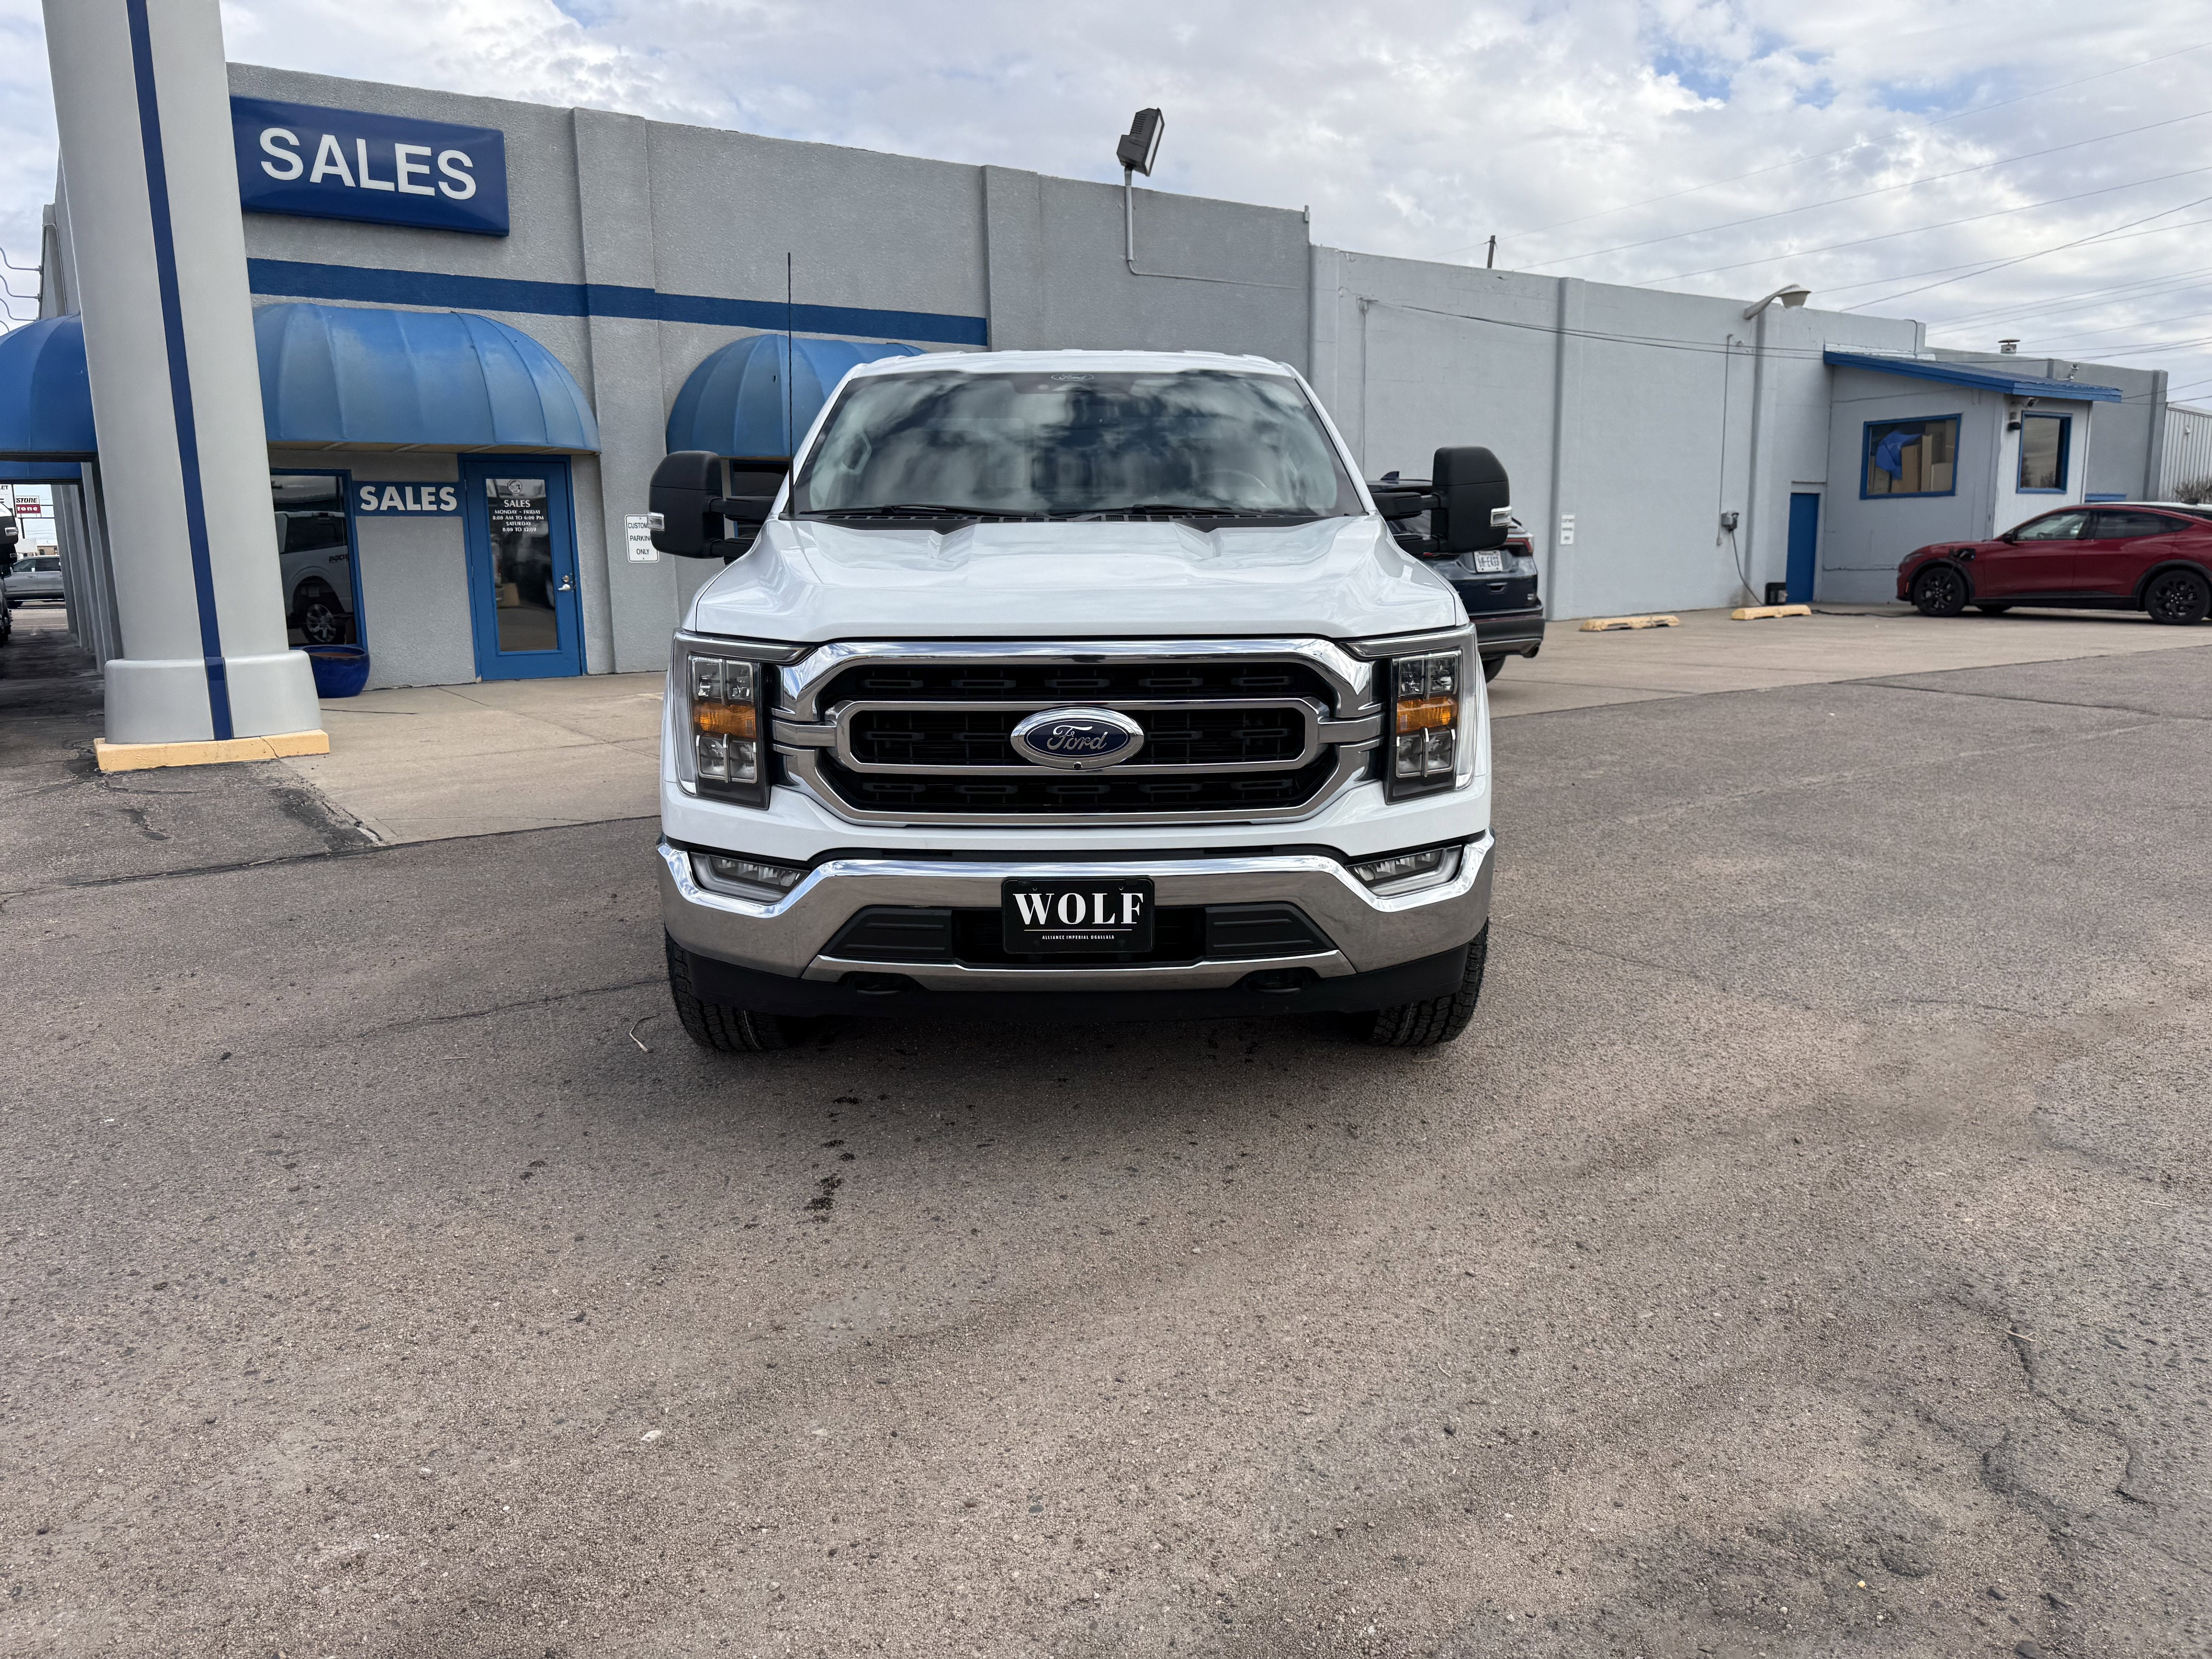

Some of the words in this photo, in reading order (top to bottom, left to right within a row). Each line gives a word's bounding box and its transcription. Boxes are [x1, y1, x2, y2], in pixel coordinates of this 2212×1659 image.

[259, 127, 476, 200] SALES
[360, 486, 457, 511] SALES
[1047, 725, 1108, 750] Ford
[1013, 893, 1144, 925] WOLF
